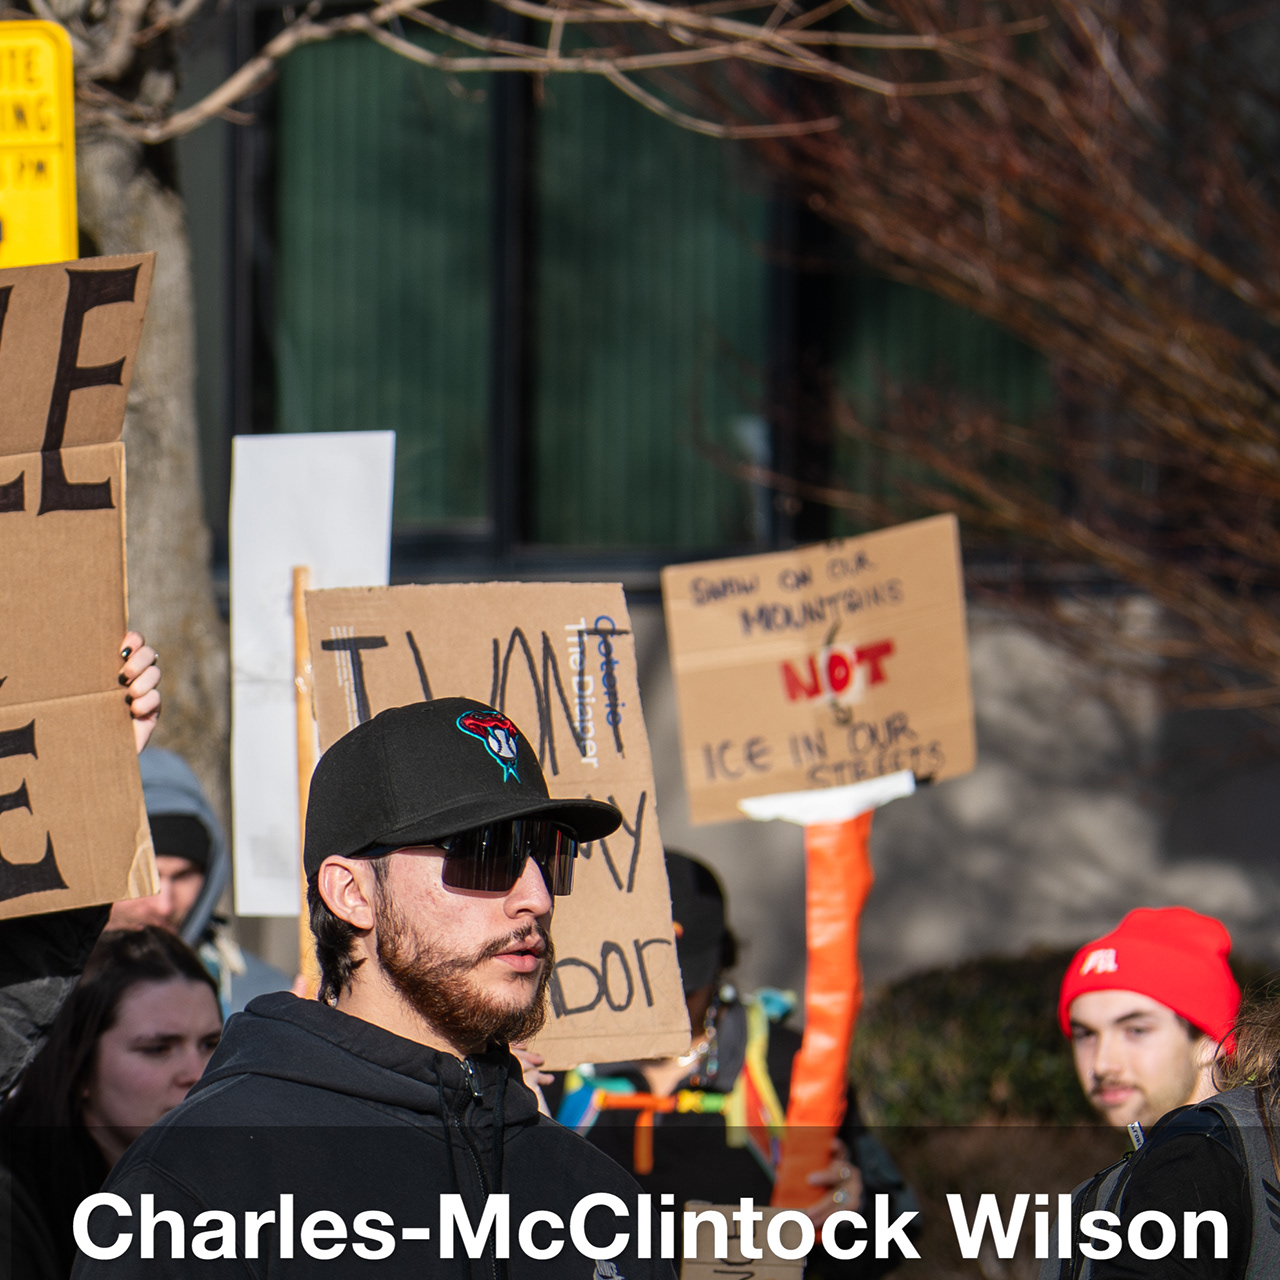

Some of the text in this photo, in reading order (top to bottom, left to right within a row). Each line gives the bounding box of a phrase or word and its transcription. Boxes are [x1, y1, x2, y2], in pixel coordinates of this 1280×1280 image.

[15, 156, 49, 185] PM
[692, 551, 878, 606] SNOW ON OUR
[740, 579, 904, 635] MOUNTAINS
[781, 638, 895, 702] NOT
[571, 674, 599, 769] Diaper
[702, 712, 917, 781] ICE IN OUR
[807, 741, 945, 786] STREETS
